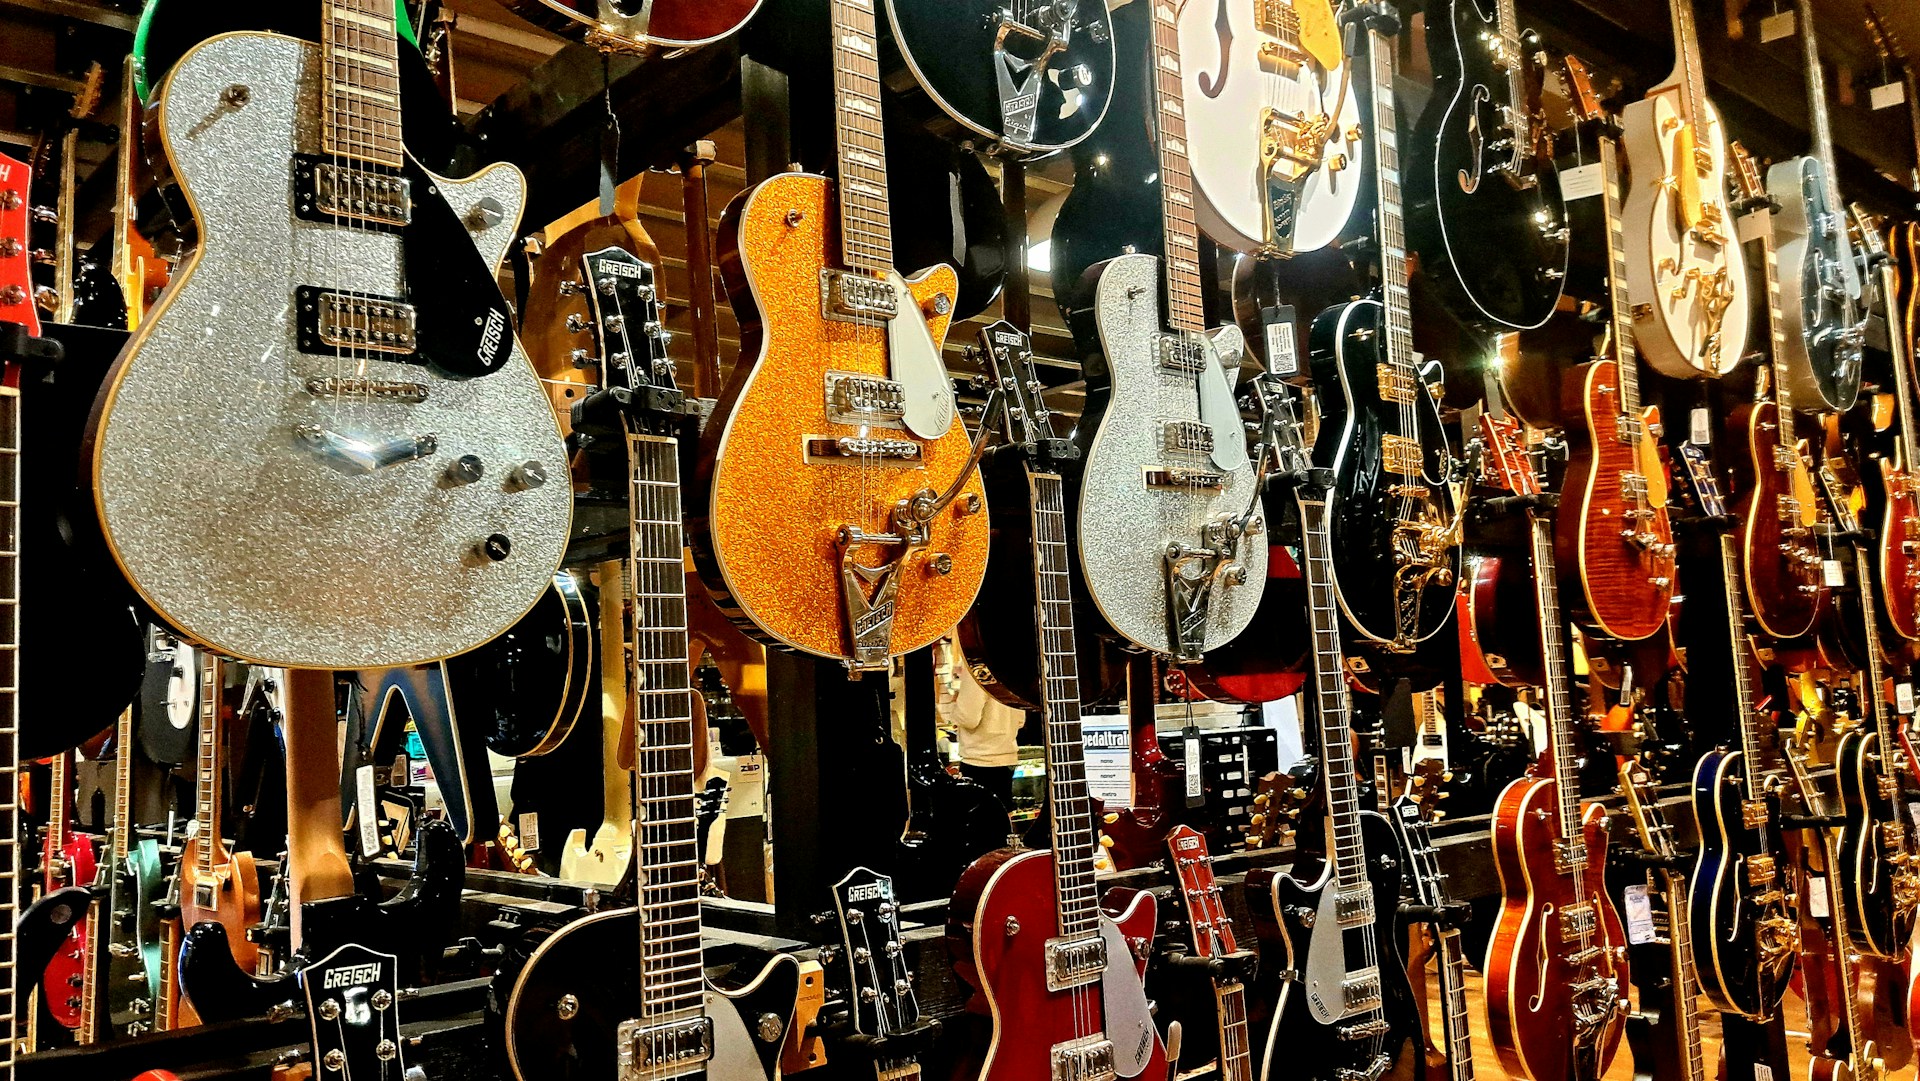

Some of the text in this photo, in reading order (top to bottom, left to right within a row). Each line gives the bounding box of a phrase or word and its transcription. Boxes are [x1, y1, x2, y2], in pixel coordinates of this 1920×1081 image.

[599, 258, 642, 280] GRETSCH
[477, 307, 505, 366] GRETSCH
[995, 331, 1023, 347] GRETSCH
[1083, 731, 1130, 749] pedaltrai
[848, 880, 884, 902] GRETSCH
[323, 962, 382, 989] GRETSCH
